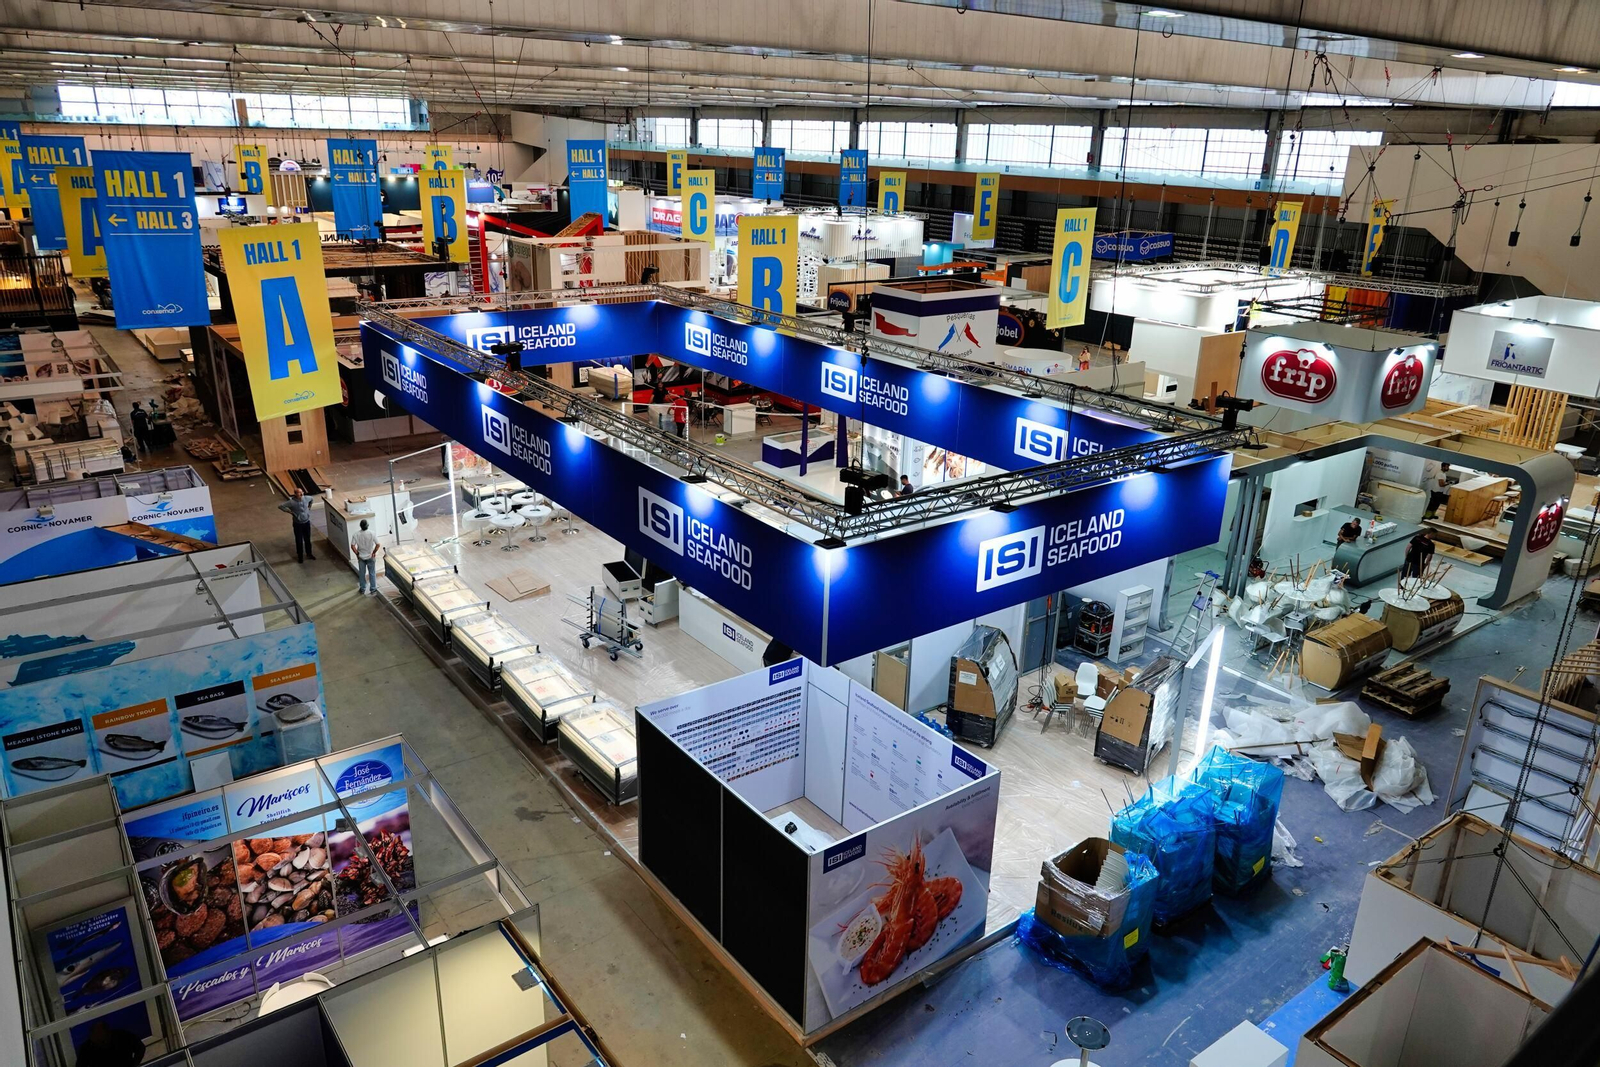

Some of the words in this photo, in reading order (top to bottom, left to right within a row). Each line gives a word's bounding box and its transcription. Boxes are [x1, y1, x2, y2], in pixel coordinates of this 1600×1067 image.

[27, 146, 70, 165] HALL
[72, 147, 82, 165] 1
[242, 149, 256, 157] HALL
[367, 149, 374, 165] 1
[431, 149, 443, 157] HALL
[444, 149, 447, 157] 1
[571, 149, 595, 163] HALL
[597, 149, 603, 163] 1
[756, 155, 776, 168] HALL
[778, 155, 783, 168] 1
[843, 156, 860, 169] HALL
[862, 156, 866, 169] 1
[244, 161, 263, 194] B
[348, 172, 369, 183] HALL
[371, 172, 377, 183] 3
[428, 177, 449, 188] HALL
[451, 177, 455, 188] 1
[582, 169, 598, 179] HALL
[599, 169, 605, 179] 3
[672, 163, 682, 189] E
[688, 176, 703, 187] HALL
[704, 177, 708, 187] 1
[779, 173, 783, 182] 3
[885, 178, 897, 186] HALL
[897, 178, 901, 186] 1
[981, 178, 991, 186] HALL
[104, 170, 168, 198] HALL
[173, 171, 186, 198] 1
[690, 192, 708, 235] C
[979, 191, 992, 226] E
[1279, 210, 1291, 222] HALL
[1292, 210, 1296, 222] 1
[136, 211, 178, 229] HALL
[181, 211, 193, 229] 3
[431, 195, 457, 245] B
[1064, 218, 1082, 233] HALL
[1083, 217, 1088, 231] 1
[751, 228, 778, 245] HALL
[780, 228, 786, 244] 1
[243, 240, 288, 265] HALL
[291, 239, 301, 260] 1
[1058, 241, 1083, 304] C
[830, 297, 849, 308] Frijobel
[260, 276, 319, 381] A
[518, 322, 576, 339] ICELAND
[519, 335, 576, 351] SEAFOOD
[687, 327, 710, 356] ISI
[712, 332, 748, 354] ICELAND
[712, 345, 748, 366] SEAFOOD
[382, 354, 402, 391] ISI
[1490, 359, 1544, 375] FRIOANTARTIC
[400, 363, 427, 390] ICELAND
[823, 366, 855, 402] ISI
[1269, 356, 1327, 398] frip
[1387, 370, 1418, 400] frip
[401, 380, 429, 404] SEAFOOD
[859, 374, 909, 402] ICELAND
[858, 391, 908, 416] SEAFOOD
[484, 408, 509, 449] ISI
[511, 422, 551, 458] ICELAND
[1018, 424, 1065, 461] ISI
[512, 443, 552, 476] SEAFOOD
[132, 513, 162, 522] CORNIC
[167, 506, 205, 517] NOVAMER
[642, 495, 680, 546] ISI
[7, 522, 43, 534] CORNIC
[49, 515, 93, 528] NOVAMER
[1049, 508, 1125, 546] ICELAND
[687, 515, 753, 568] ICELAND
[1047, 530, 1122, 567] SEAFOOD
[687, 538, 752, 590] SEAFOOD
[982, 534, 1040, 583] ISI
[723, 624, 735, 640] ISI
[736, 632, 754, 646] ICELAND
[736, 637, 754, 652] SEAFOOD
[270, 676, 281, 684] SEA
[281, 672, 301, 681] BREAM
[773, 671, 784, 680] ISI
[197, 694, 209, 702] SEA
[209, 690, 225, 699] BASS
[105, 712, 136, 724] RAINBOW
[136, 707, 157, 717] TROUT
[7, 736, 35, 747] MEAGRE
[36, 730, 60, 741] (STONE
[61, 725, 81, 735] BASS)
[354, 765, 370, 777] José
[955, 756, 967, 770] ISI
[344, 773, 382, 790] Fernández
[236, 783, 311, 818] Mariscos
[266, 808, 291, 819] Shellfish
[842, 844, 863, 856] ICELAND
[842, 849, 862, 860] SEAFOOD
[828, 853, 842, 866] ISI
[179, 970, 241, 1000] Pescados
[239, 966, 250, 980] y
[256, 938, 323, 968] Mariscos
